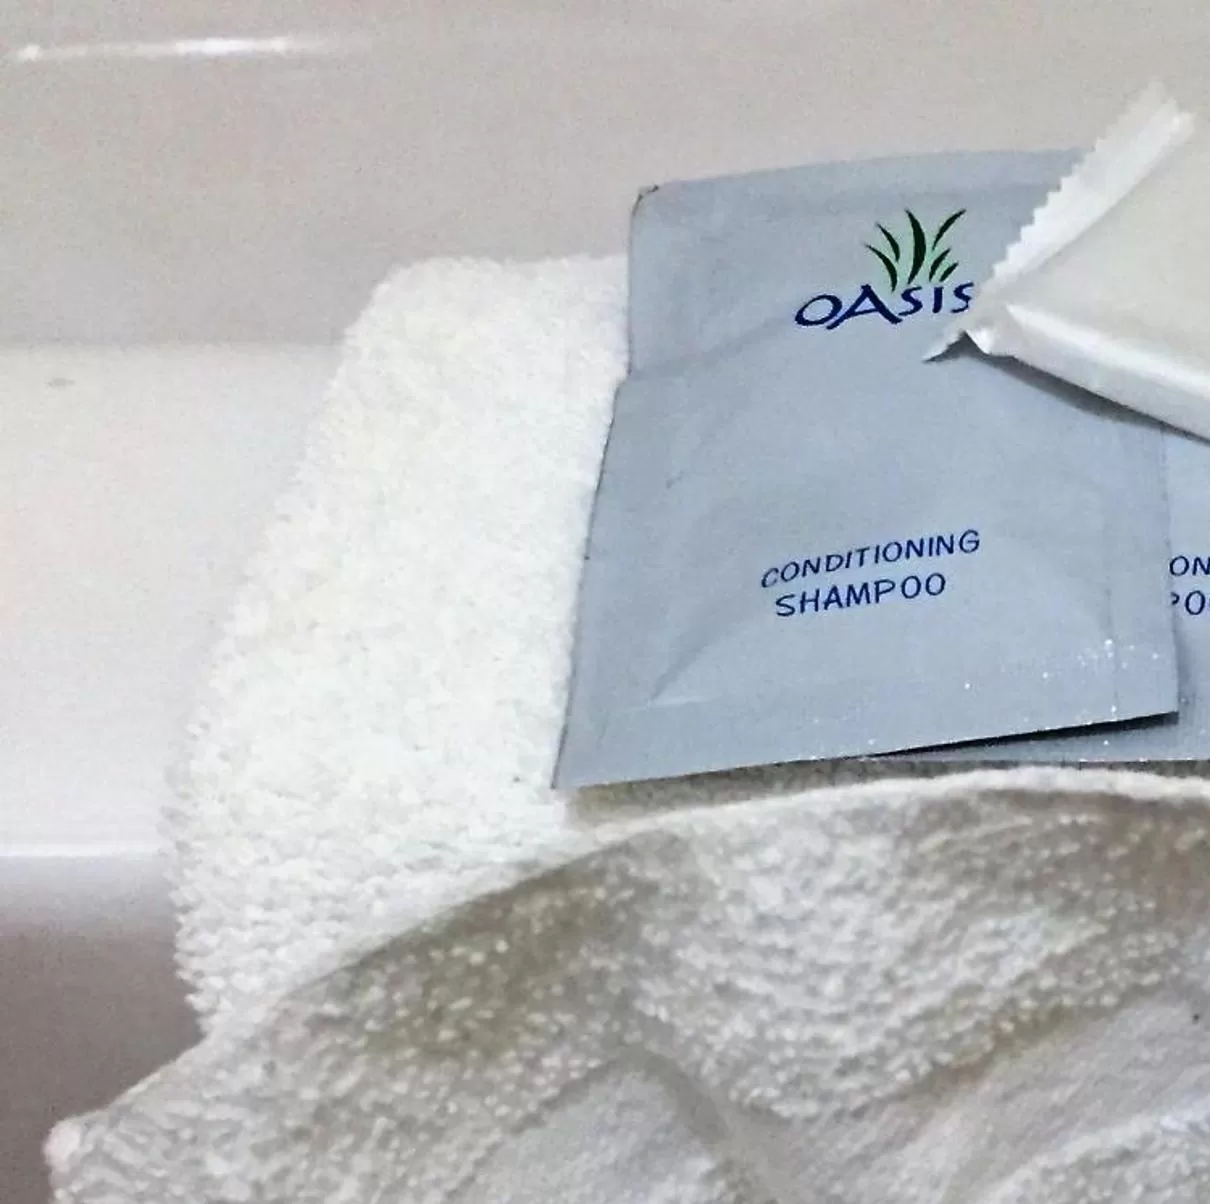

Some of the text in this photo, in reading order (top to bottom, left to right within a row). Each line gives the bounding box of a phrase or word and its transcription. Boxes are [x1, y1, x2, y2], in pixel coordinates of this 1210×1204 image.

[794, 282, 975, 330] OASIS
[761, 529, 980, 588] CONDITIONING
[775, 572, 946, 617] SHAMPOO
